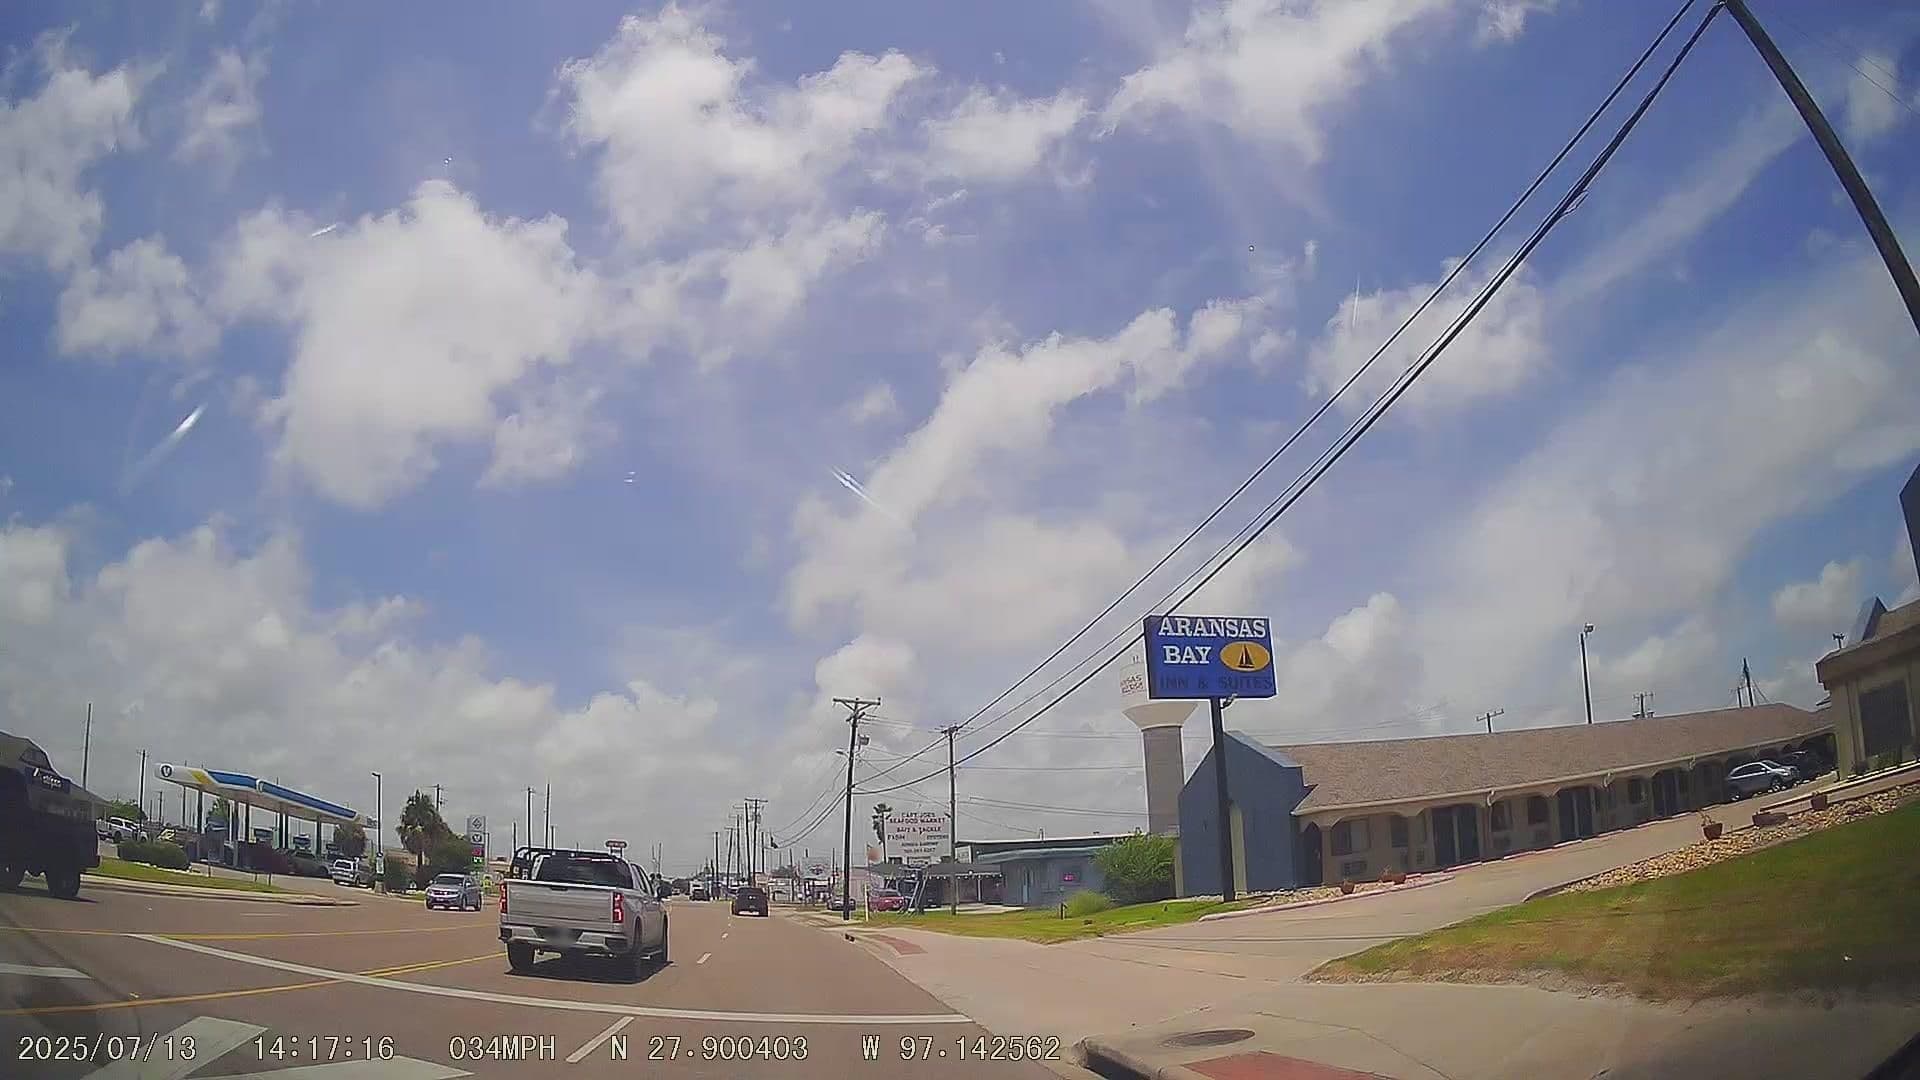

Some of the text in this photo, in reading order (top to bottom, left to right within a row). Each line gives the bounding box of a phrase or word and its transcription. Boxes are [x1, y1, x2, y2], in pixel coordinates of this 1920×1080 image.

[1158, 617, 1266, 638] ARANSAS
[1163, 645, 1212, 664] BAY
[1159, 675, 1189, 689] INN
[1218, 675, 1274, 690] SUITES
